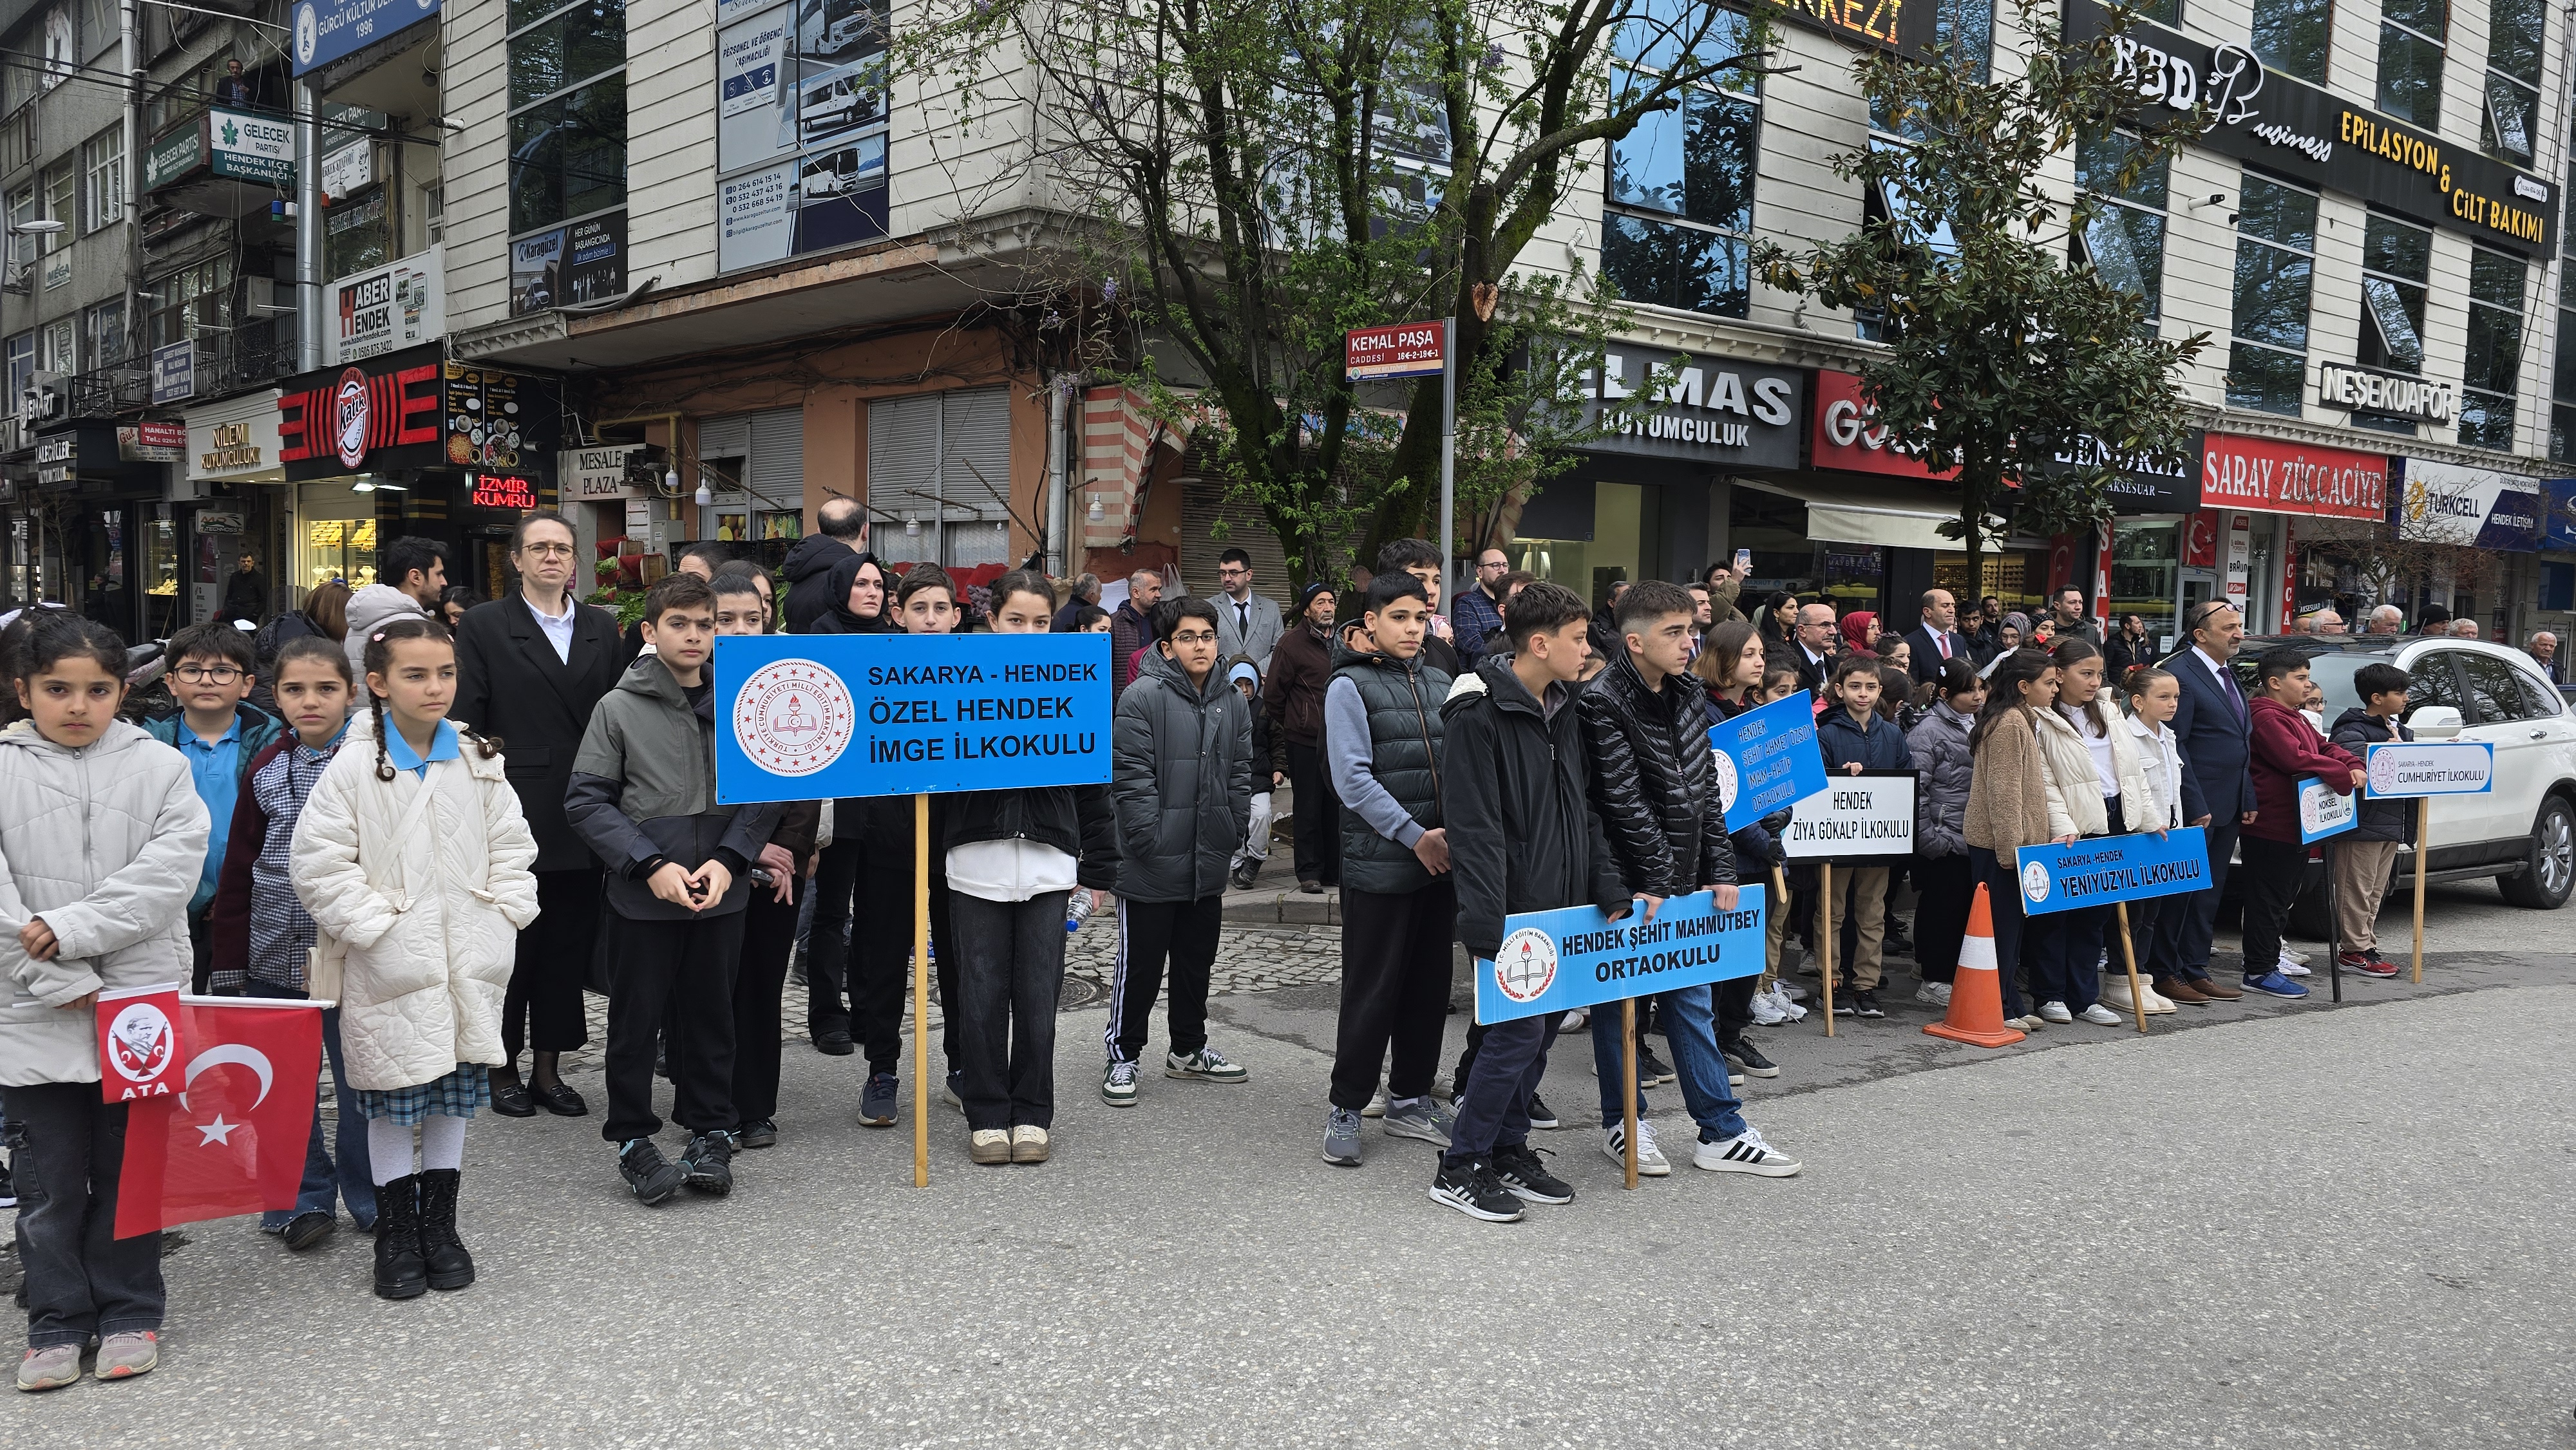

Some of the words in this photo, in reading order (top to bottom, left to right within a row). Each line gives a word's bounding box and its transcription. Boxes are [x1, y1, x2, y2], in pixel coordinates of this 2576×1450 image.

[318, 6, 345, 36] GÜRCÜ
[356, 18, 374, 39] 1996
[723, 40, 750, 59] PERSONEL
[751, 37, 759, 48] VE
[759, 24, 784, 44] ÖĞRENCİ
[735, 44, 770, 68] TAŞIMACILIĞI
[243, 123, 290, 144] GELECEK
[158, 146, 179, 168] GELECEK
[223, 153, 265, 167] HENDEK
[267, 160, 289, 173] İLÇE
[226, 163, 288, 180] BAŞKANLIĞI
[738, 181, 751, 191] 264
[752, 178, 764, 187] 614
[765, 174, 772, 183] 15
[773, 172, 781, 181] 14
[2439, 164, 2450, 193] &
[738, 192, 750, 202] 532
[751, 188, 764, 197] 437
[765, 185, 774, 193] 43
[738, 202, 750, 212] 532
[752, 199, 764, 208] 668
[766, 195, 774, 204] 54
[733, 206, 781, 223] www.karaguzeltur.com
[2490, 200, 2543, 243] BAKIMI
[574, 228, 583, 238] HER
[583, 221, 601, 235] GÜNÜN
[526, 234, 558, 259] Karagüzel
[574, 233, 611, 251] BAŞLANGICINDA
[341, 278, 389, 312] HABER
[341, 306, 391, 339] HENDEK
[340, 328, 392, 348] www.haberhendek.com
[358, 345, 370, 358] 0505
[371, 343, 379, 355] 875
[381, 339, 393, 353] 3422
[1352, 333, 1396, 352] KEMAL
[1399, 330, 1434, 348] PAŞA
[1350, 352, 1385, 364] CADDESİ
[1556, 348, 1792, 426] ELMAS
[119, 428, 135, 445] Gül
[144, 426, 175, 435] HANALTI
[200, 447, 256, 469] KUYUMCULUK
[341, 450, 363, 467] HENDEK
[478, 474, 529, 494] İZMİR
[583, 476, 618, 495] PLAZA
[2106, 480, 2156, 496] AKSESUAR
[2204, 451, 2274, 498] SARAY
[2279, 455, 2382, 509] ZÜCCACİYE
[473, 490, 535, 508] KUMRU
[2427, 492, 2480, 518] TURKCELL
[2491, 513, 2512, 526] HENDEK
[1828, 560, 1882, 569] MAYBELLINE
[2229, 560, 2248, 573] BRAUN
[868, 665, 983, 686] SAKARYA
[1005, 663, 1098, 683] HENDEK
[758, 683, 790, 727] CUMHURİYETİ
[813, 689, 831, 714] EĞİTİM
[869, 697, 948, 724] ÖZEL
[957, 696, 1074, 722] HENDEK
[760, 727, 788, 753] TÜRKİYE
[804, 715, 831, 751] BAKANLIĞI
[1738, 719, 1768, 743] HENDEK
[869, 735, 945, 764] İMGE
[954, 731, 1096, 760] İLKOKULU
[1741, 742, 1764, 767] ŞEHİT
[1765, 733, 1788, 758] AHMET
[1790, 723, 1813, 746] ÖZSOY
[1746, 755, 1792, 790] İMAM-HATİP
[2398, 769, 2447, 783] CUMHURİYET
[2448, 768, 2485, 782] İLKOKULU
[1752, 779, 1796, 813] ORTAOKULU
[1833, 791, 1873, 810] HENDEK
[2318, 797, 2338, 811] NOKSEL
[2319, 808, 2343, 824] İLKOKULU
[1793, 818, 1816, 841] ZİYA
[1819, 817, 1858, 840] GÖKALP
[1861, 816, 1909, 839] İLKOKULU
[2057, 853, 2092, 869] SAKARYA
[2059, 867, 2139, 899] YENİYÜZYIL
[2139, 858, 2201, 887] İLKOKULU
[1562, 928, 1625, 957] HENDEK
[1629, 918, 1672, 952] ŞEHİT
[1676, 909, 1761, 940] MAHMUTBEY
[1534, 932, 1555, 957] BAKANLIĞI
[1595, 943, 1721, 983] ORTAOKULU
[120, 1082, 170, 1100] ATA
